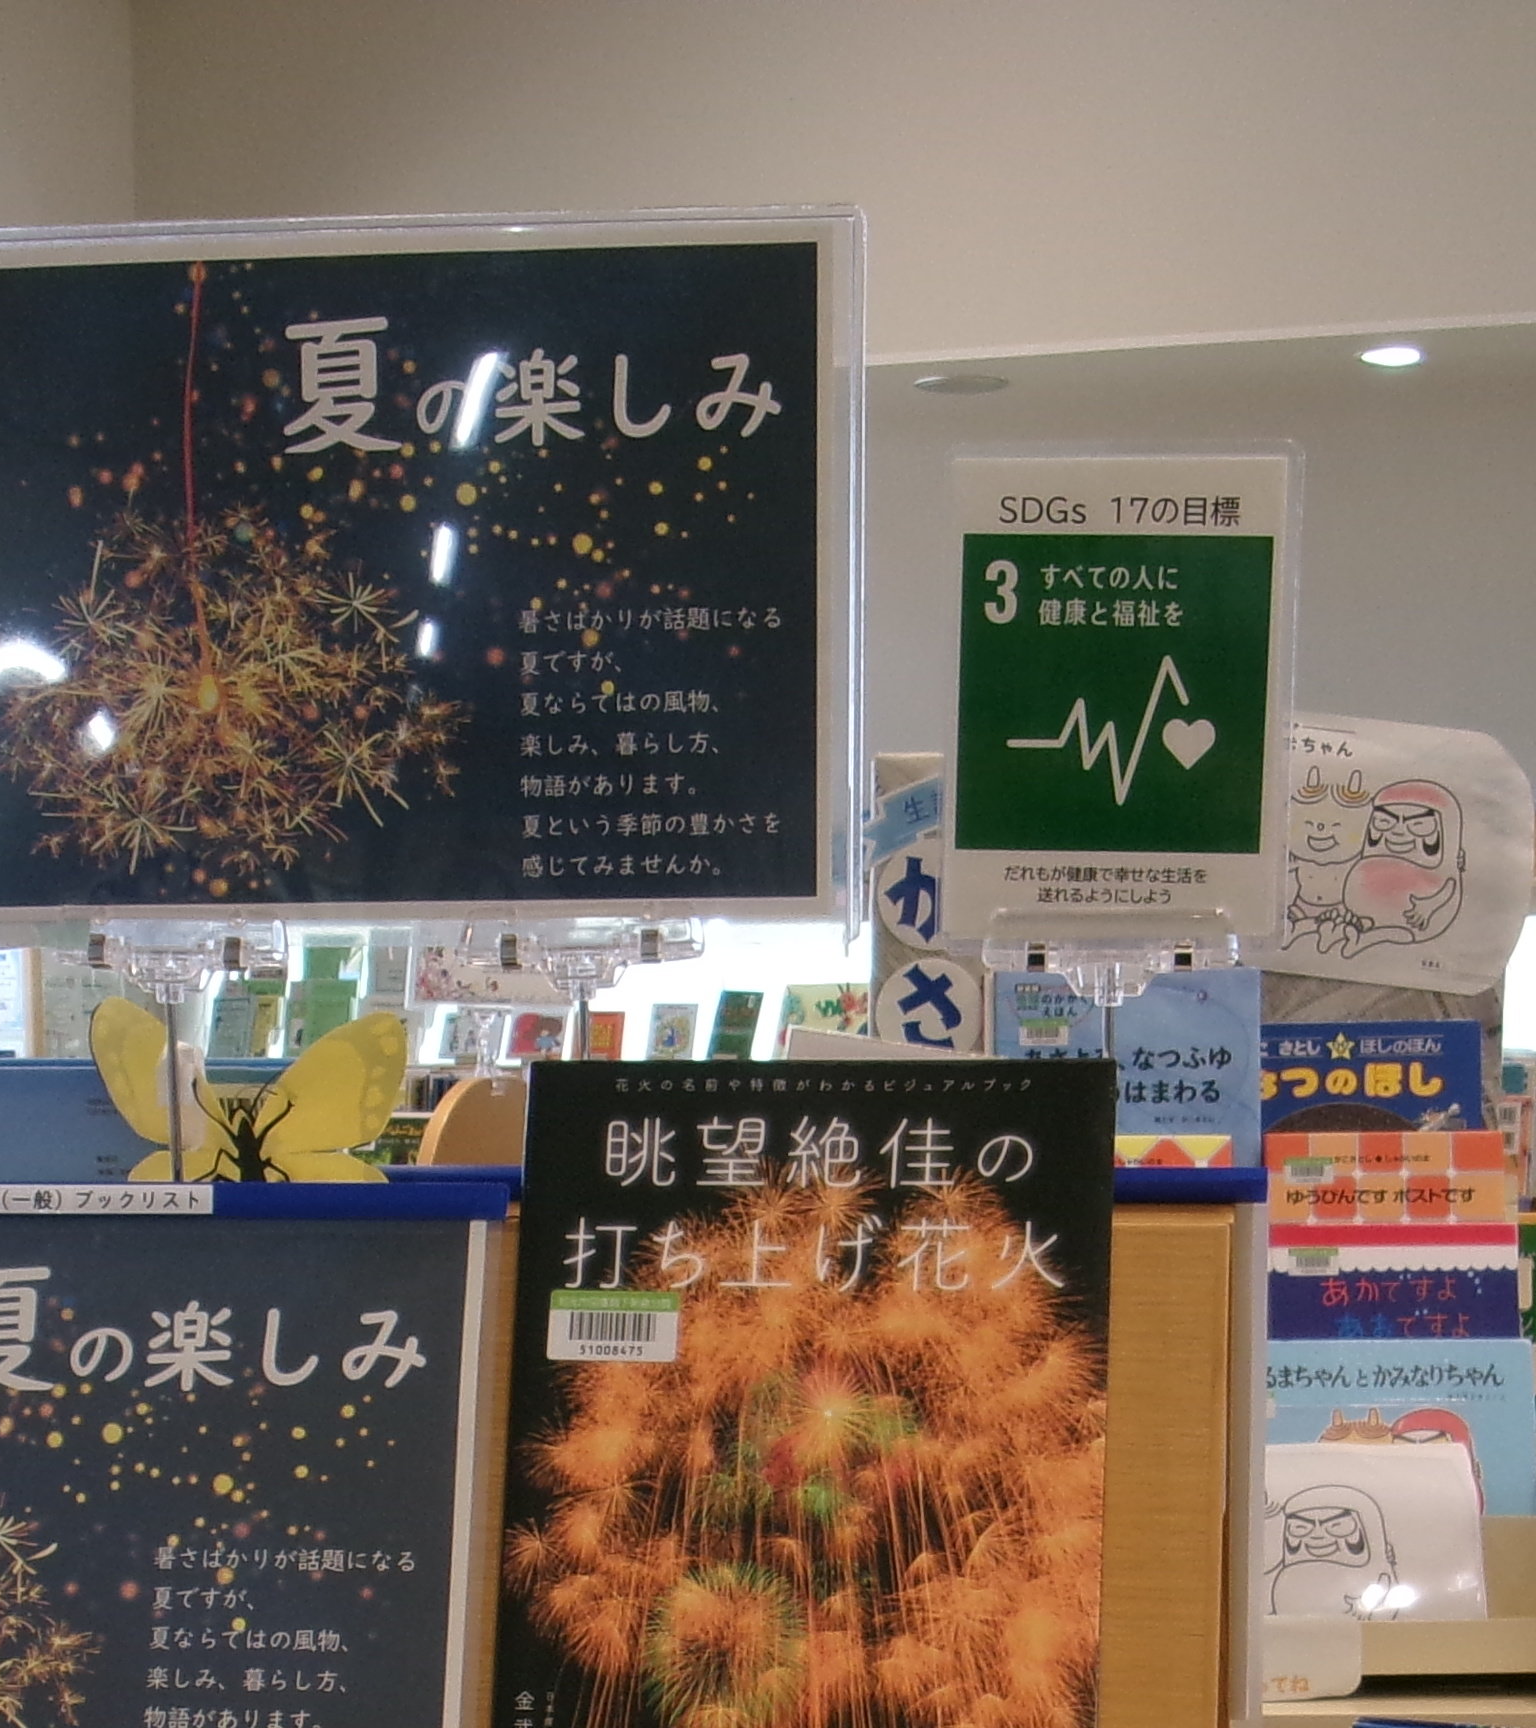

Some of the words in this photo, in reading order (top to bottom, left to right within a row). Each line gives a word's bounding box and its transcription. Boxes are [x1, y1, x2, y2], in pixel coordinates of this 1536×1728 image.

[284, 315, 781, 455] 夏の楽しみ
[999, 496, 1087, 525] SDGs
[1110, 495, 1240, 527] 17の目標
[1040, 565, 1178, 590] すべての人に
[984, 561, 1018, 624] 3
[519, 607, 781, 633] 暑さばかりが話題になる
[1038, 600, 1183, 627] 健康と福祉を
[519, 649, 620, 675] 夏ですが、
[519, 690, 720, 717] 夏ならではの風物、
[520, 732, 721, 757] 楽しみ、暮らし方、
[520, 772, 699, 798] 物語があります。
[522, 812, 780, 839] 夏という季節の豊かさを
[522, 853, 722, 879] 感じてみませんか。
[1004, 865, 1207, 884] だれもが健康で幸せな生活を
[1037, 887, 1171, 905] 送れるようにしよう
[615, 1077, 1034, 1095] 花火の名前や特徴がわかるビジュアルブック
[605, 1115, 1033, 1187] 眺望絶佳の
[76, 1187, 202, 1210] ブックリスト
[1286, 1187, 1386, 1204] ゆうびんです
[1393, 1187, 1475, 1204] ポストです
[565, 1217, 1065, 1291] 打ち上げ花火
[1321, 1278, 1456, 1306] あかですよ
[154, 1546, 416, 1572] 暑さばかりが話題になる
[153, 1587, 254, 1611] 夏ですが、
[151, 1626, 350, 1652] 夏ならではの風物、
[147, 1667, 349, 1693] 楽しみ、暮らし方、
